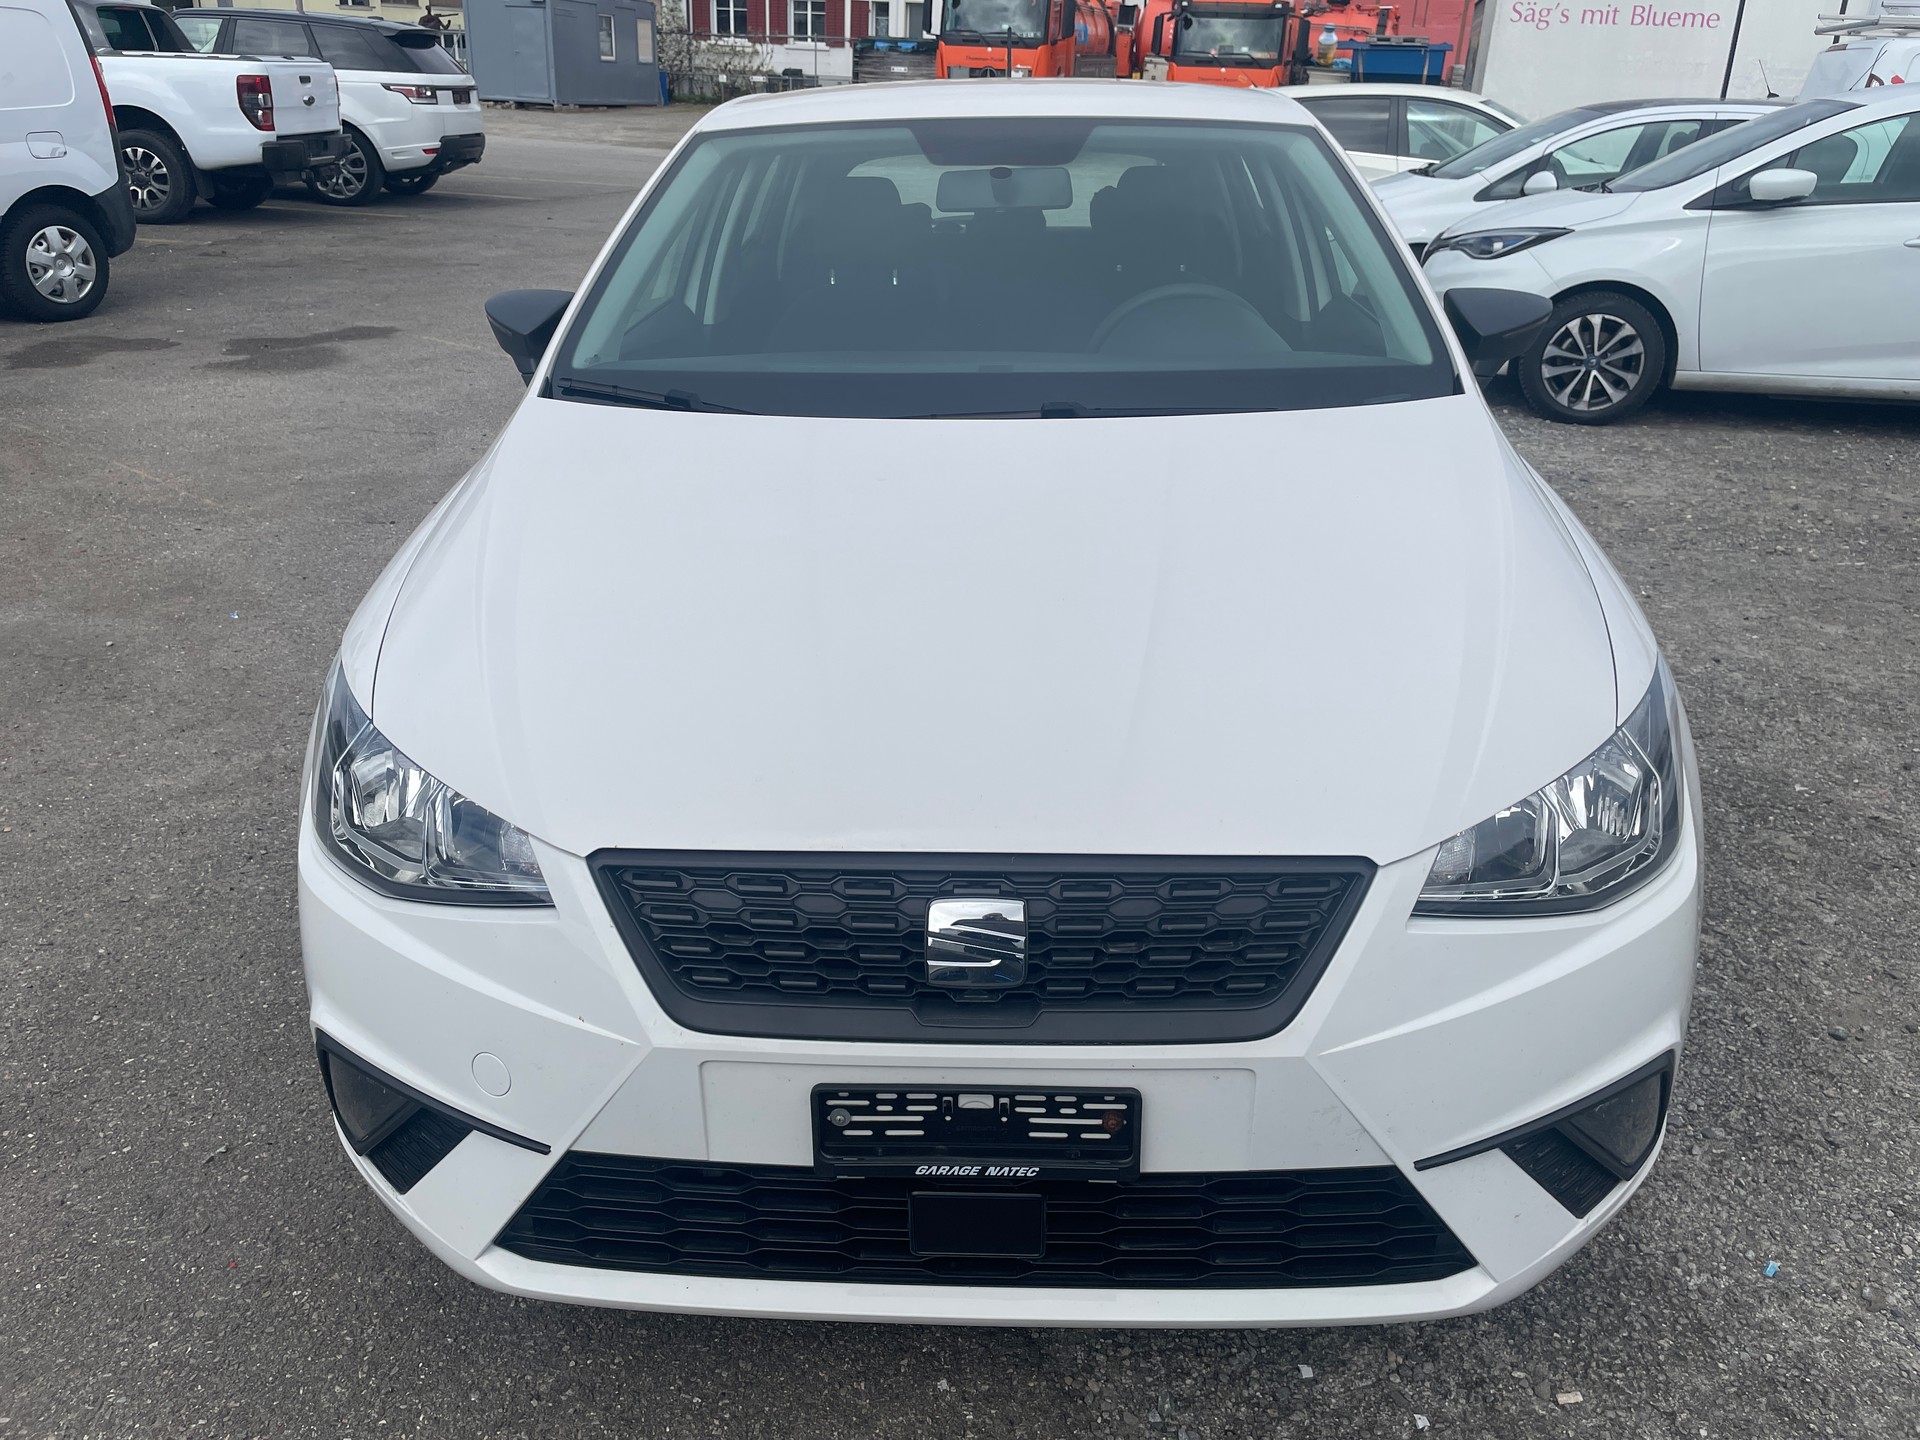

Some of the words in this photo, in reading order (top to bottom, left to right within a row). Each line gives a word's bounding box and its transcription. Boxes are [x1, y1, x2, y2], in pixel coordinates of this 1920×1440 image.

[1509, 1, 1570, 31] Säg's
[1580, 4, 1620, 26] mit
[1630, 4, 1721, 29] Blueme
[914, 1165, 982, 1176] GARAGE
[984, 1166, 1040, 1177] NATEC
